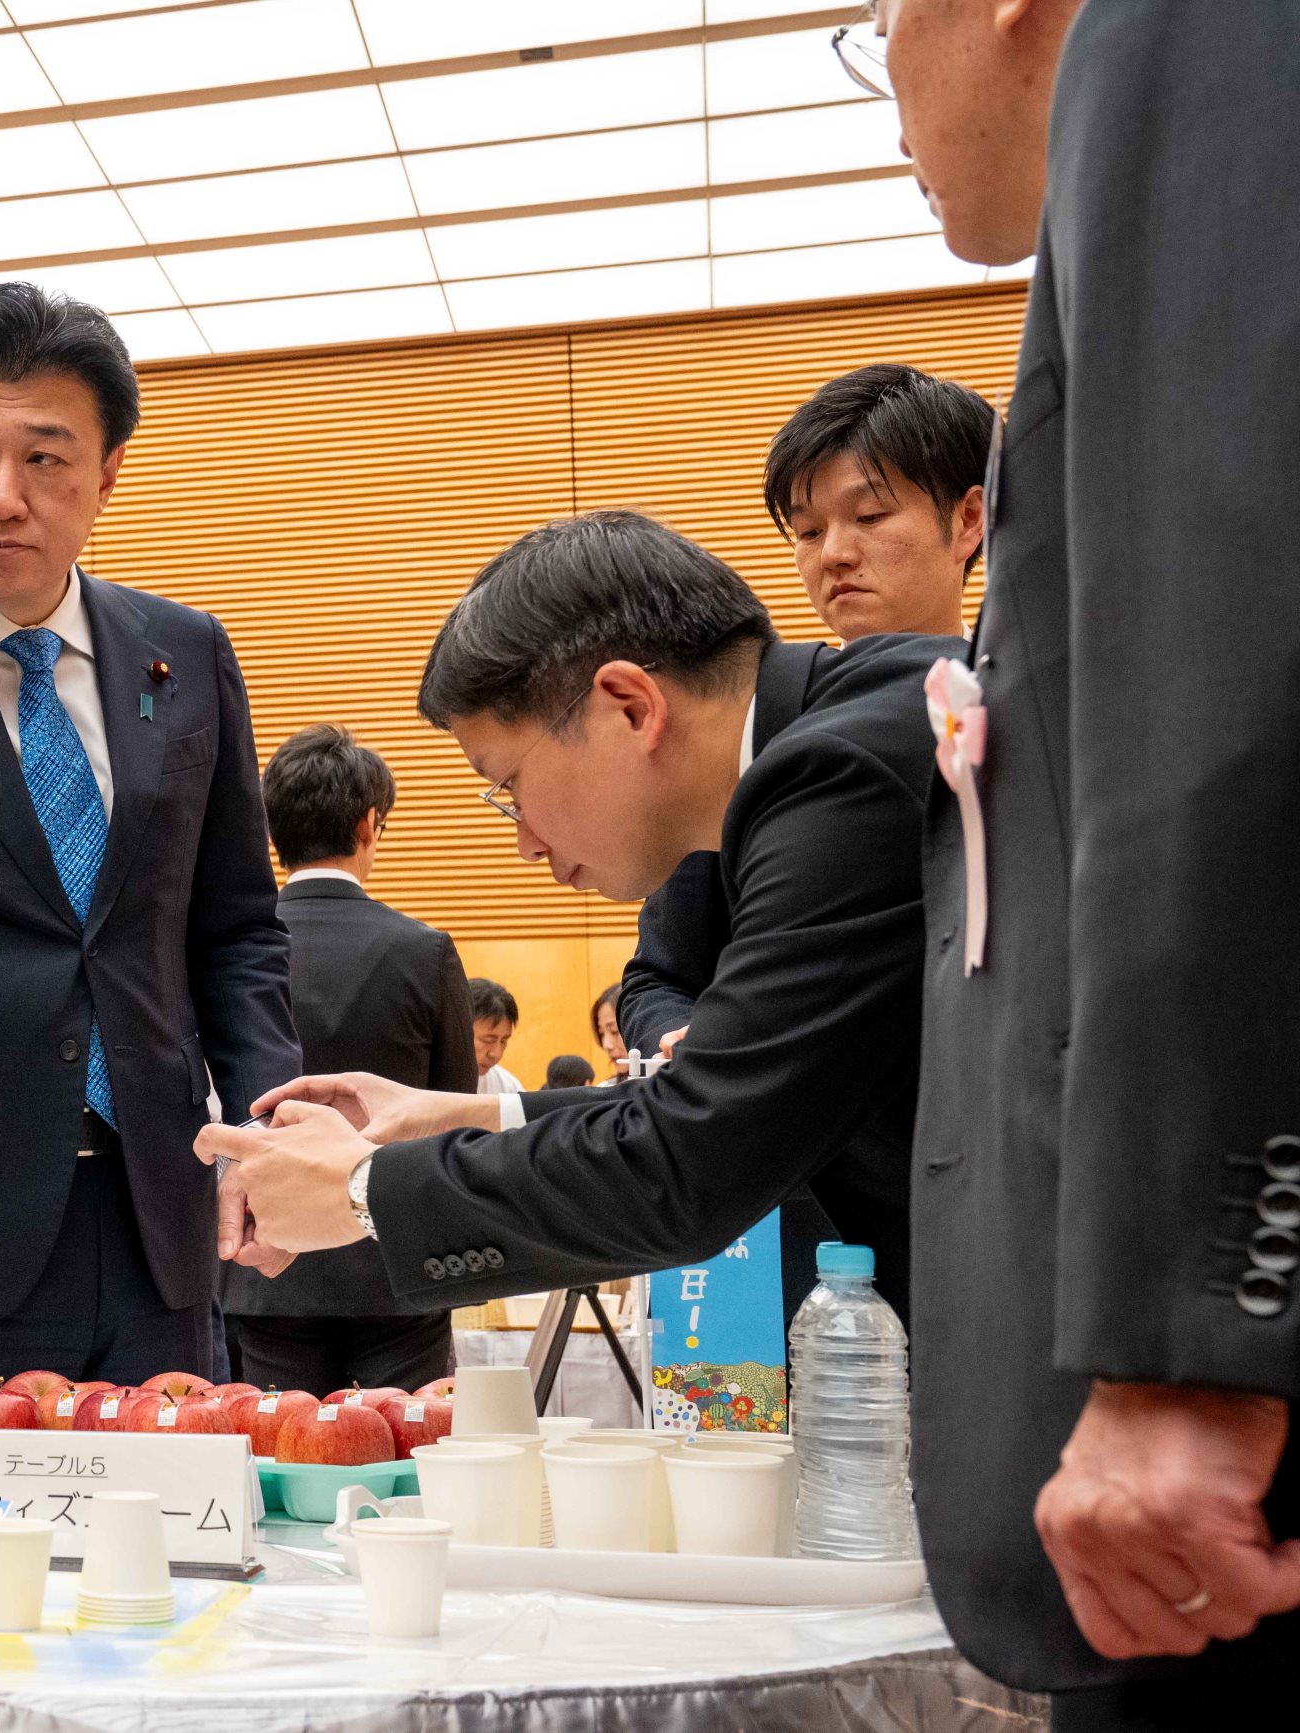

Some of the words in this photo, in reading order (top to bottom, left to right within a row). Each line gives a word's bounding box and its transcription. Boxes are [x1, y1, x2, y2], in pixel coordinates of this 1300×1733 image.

[680, 1269, 709, 1349] 日!
[5, 1454, 106, 1475] テーブル5
